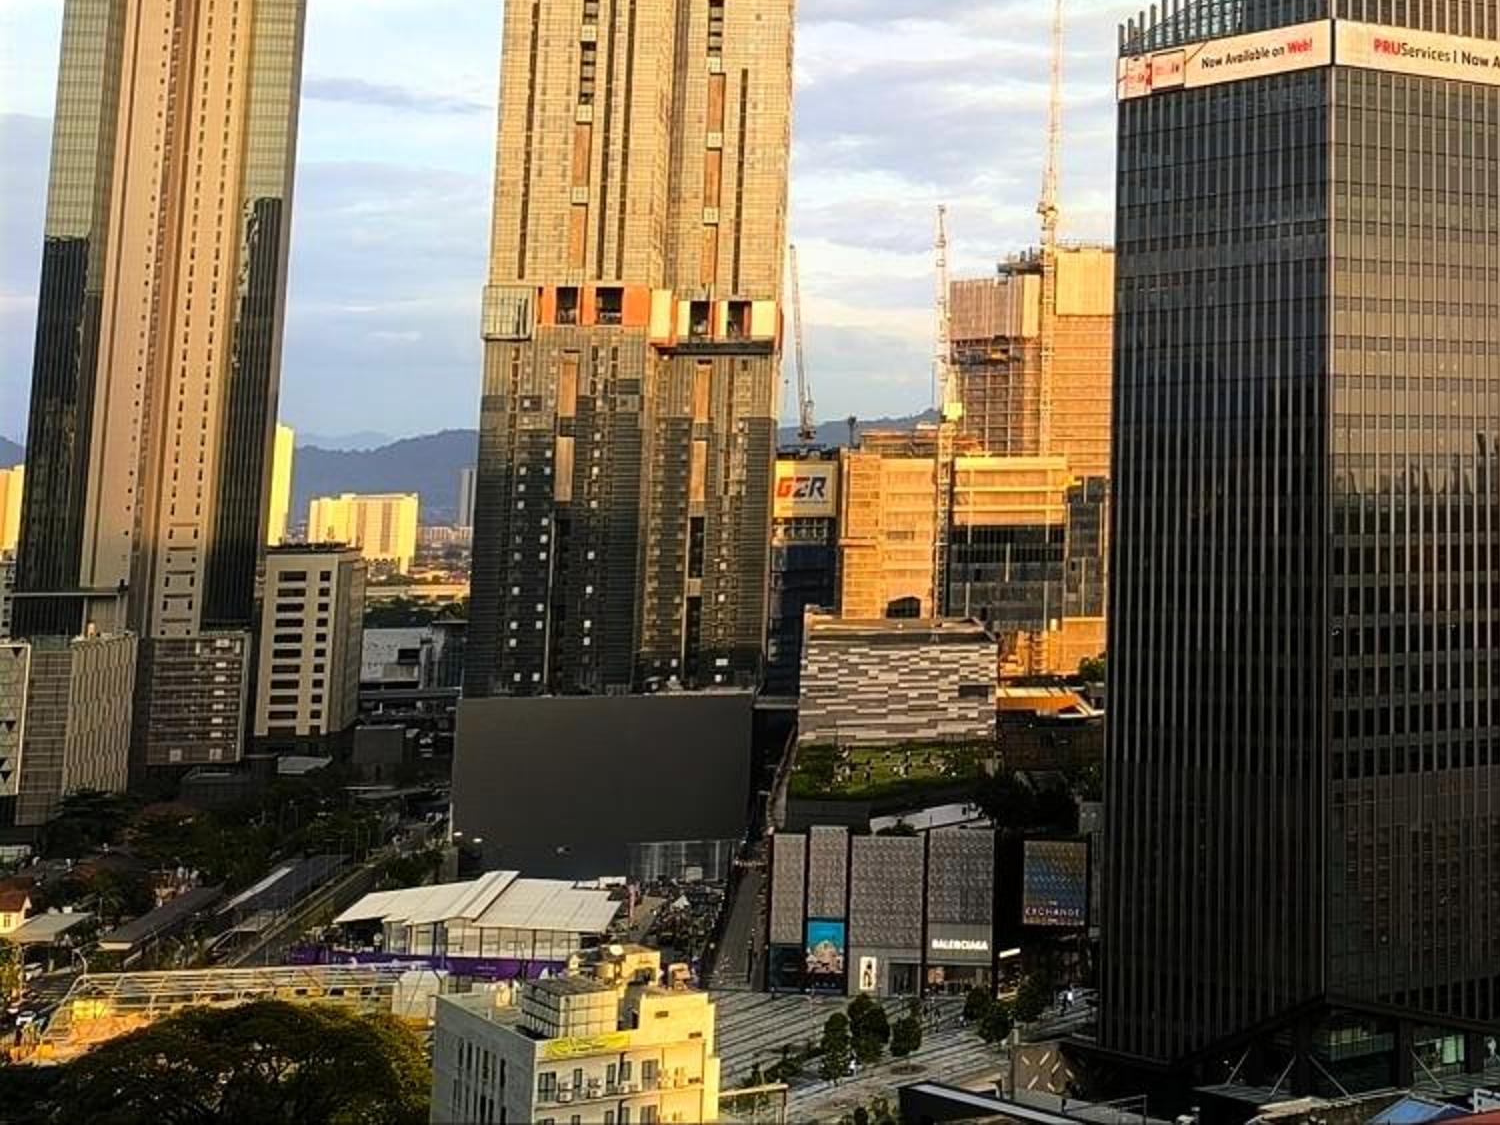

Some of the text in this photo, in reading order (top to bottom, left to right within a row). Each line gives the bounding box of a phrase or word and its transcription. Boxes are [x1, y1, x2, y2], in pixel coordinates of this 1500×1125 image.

[1201, 37, 1313, 69] Now Available on Web!
[1374, 38, 1451, 63] PRUServices
[1461, 51, 1489, 66] Now
